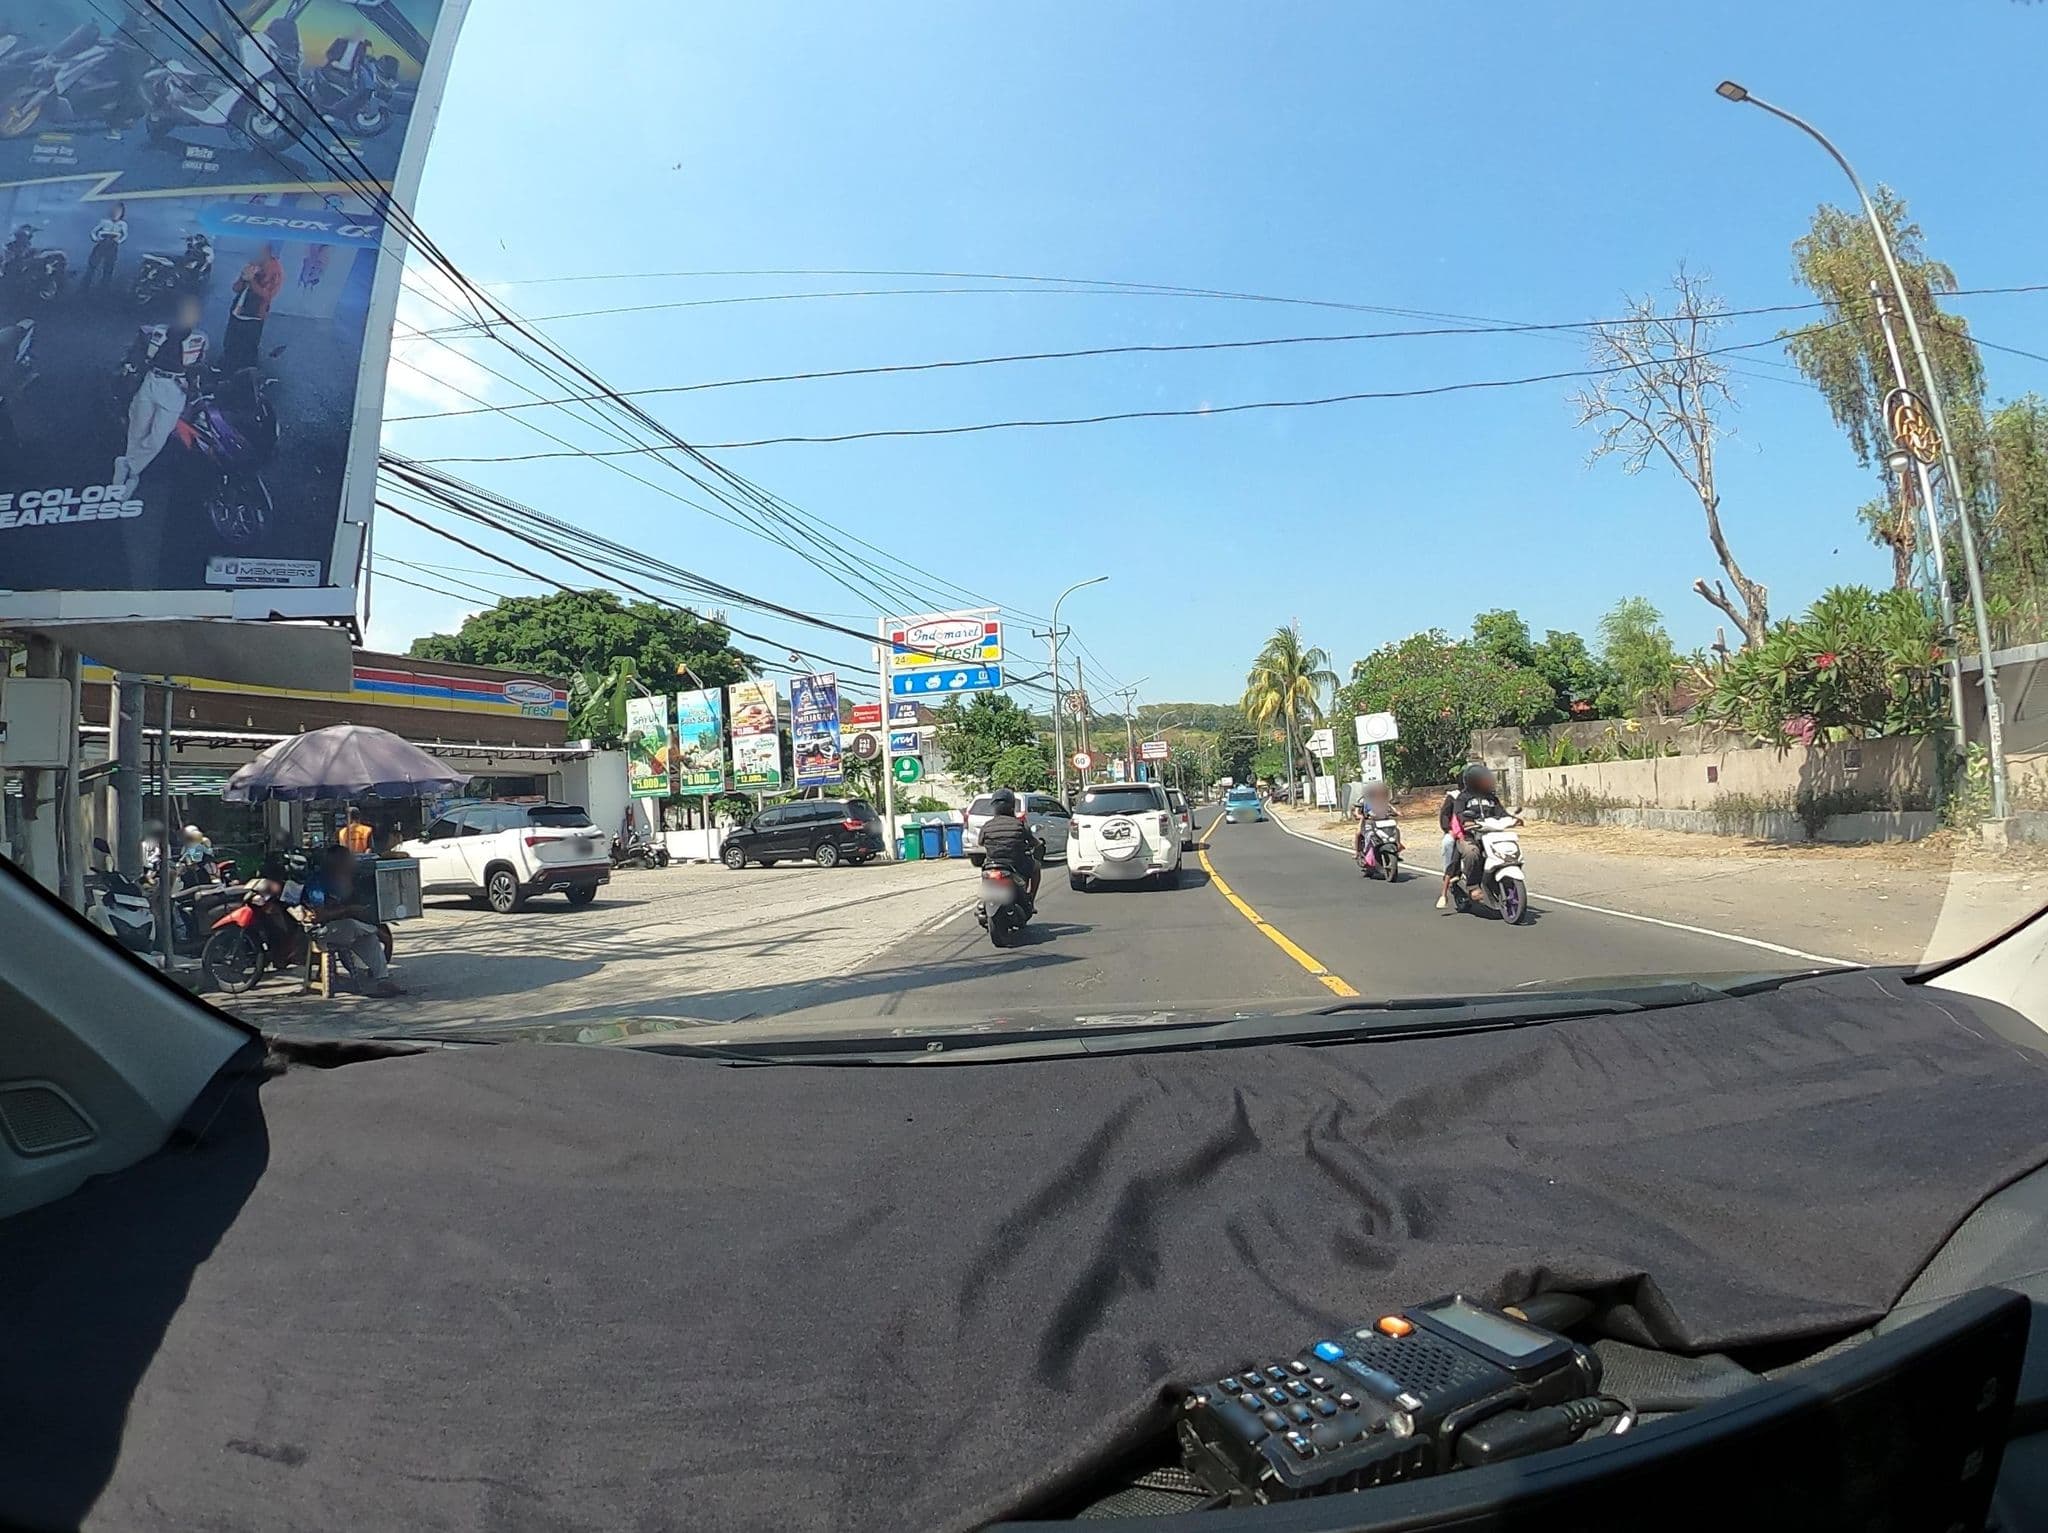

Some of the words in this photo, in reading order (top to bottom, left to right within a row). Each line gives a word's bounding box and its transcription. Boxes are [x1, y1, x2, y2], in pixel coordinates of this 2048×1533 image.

[19, 484, 128, 509] COLOR
[240, 567, 316, 577] MEMBERS
[934, 644, 982, 662] Fresh
[520, 701, 553, 716] Fresh
